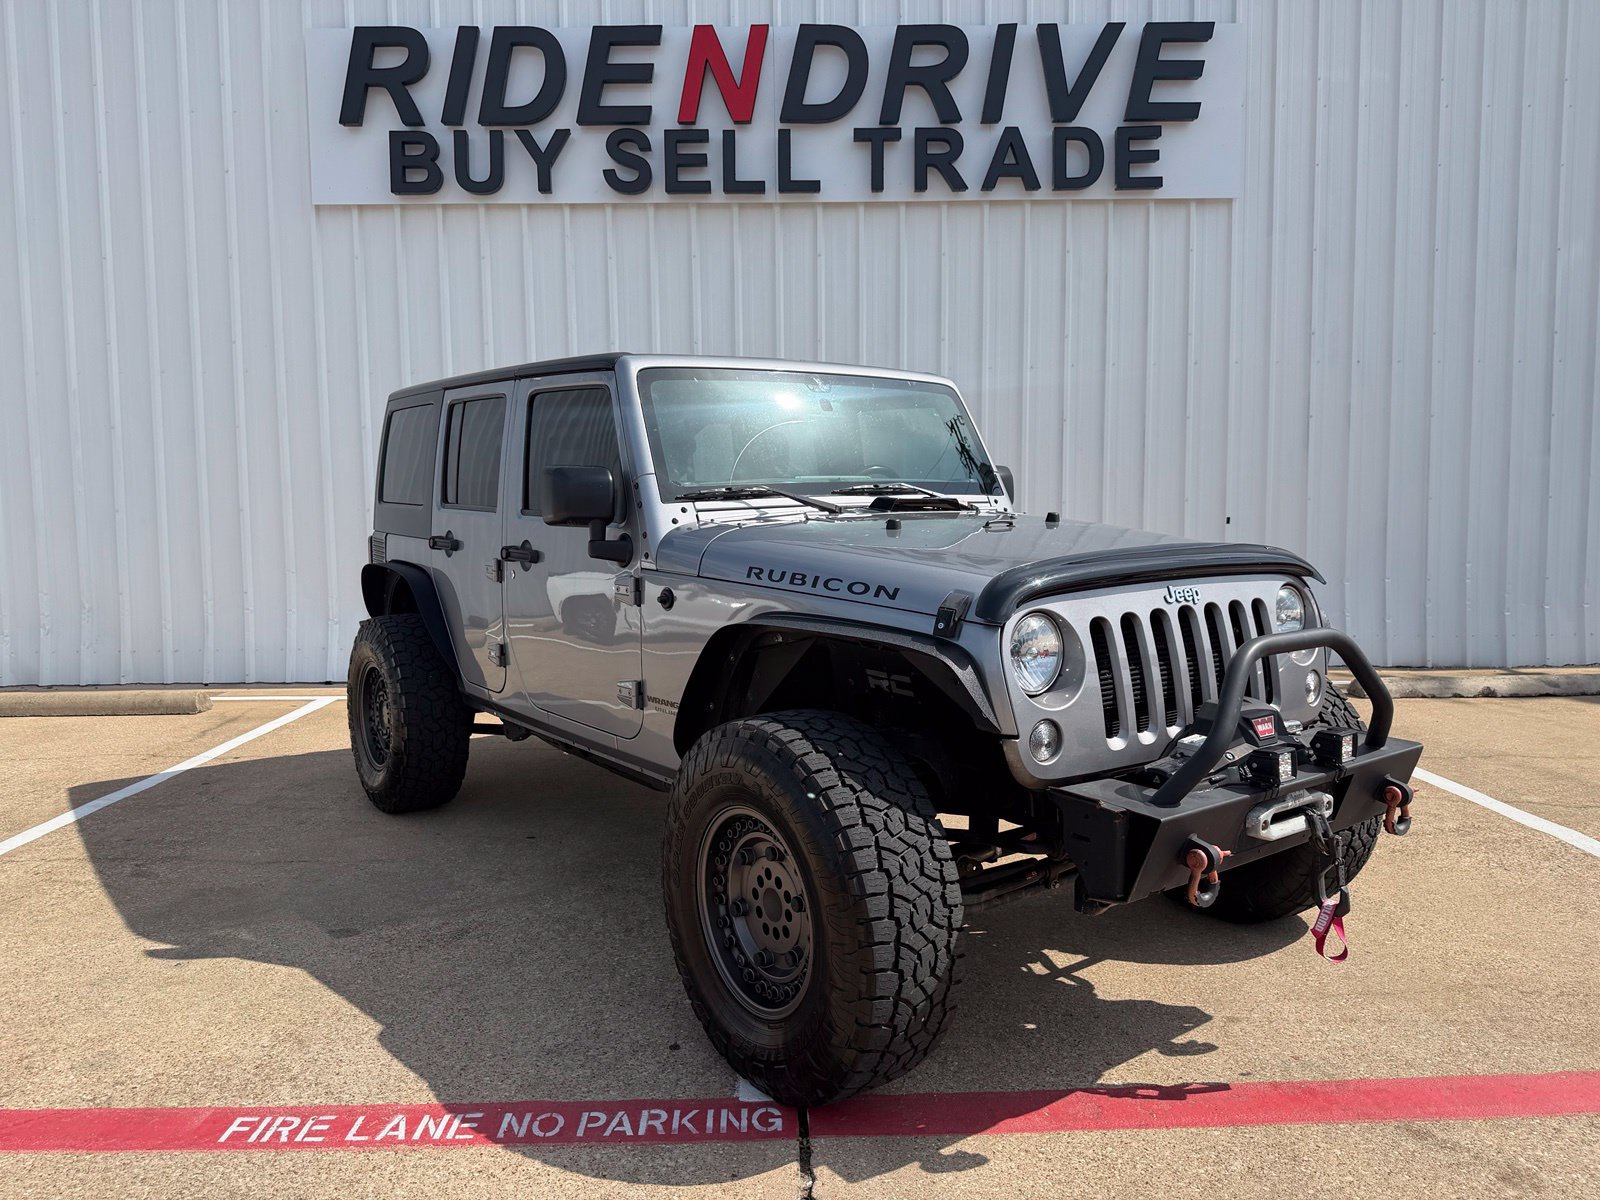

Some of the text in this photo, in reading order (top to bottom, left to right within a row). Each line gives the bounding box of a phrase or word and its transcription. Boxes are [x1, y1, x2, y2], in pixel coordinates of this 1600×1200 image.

[389, 125, 1163, 195] BUY SELL TRADE
[746, 566, 900, 600] RUBICON
[1163, 585, 1201, 605] Jeep
[217, 1107, 784, 1142] FIRE LANE NO PARKING
